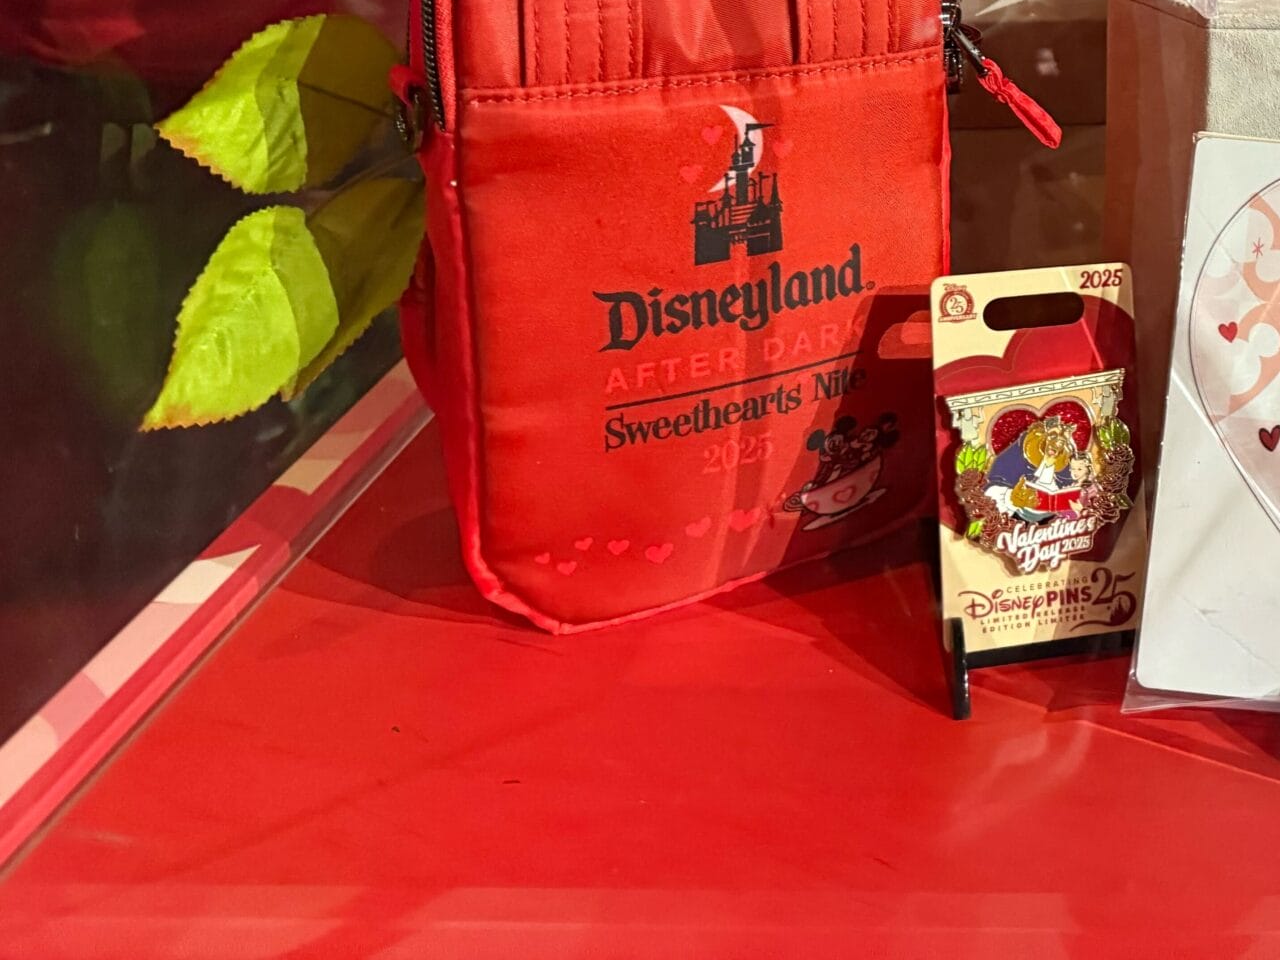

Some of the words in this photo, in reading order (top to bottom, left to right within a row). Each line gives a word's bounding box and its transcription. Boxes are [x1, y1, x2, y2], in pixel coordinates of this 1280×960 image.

[1079, 268, 1124, 290] 2025
[604, 346, 741, 393] AFTER
[604, 383, 803, 453] Sweethearts
[704, 433, 774, 473] 2025
[1016, 541, 1067, 573] Day
[1061, 535, 1091, 553] 2025
[1006, 575, 1089, 595] CELEBRATING
[979, 612, 1029, 626] LIMITED
[1036, 605, 1087, 618] RELEASE
